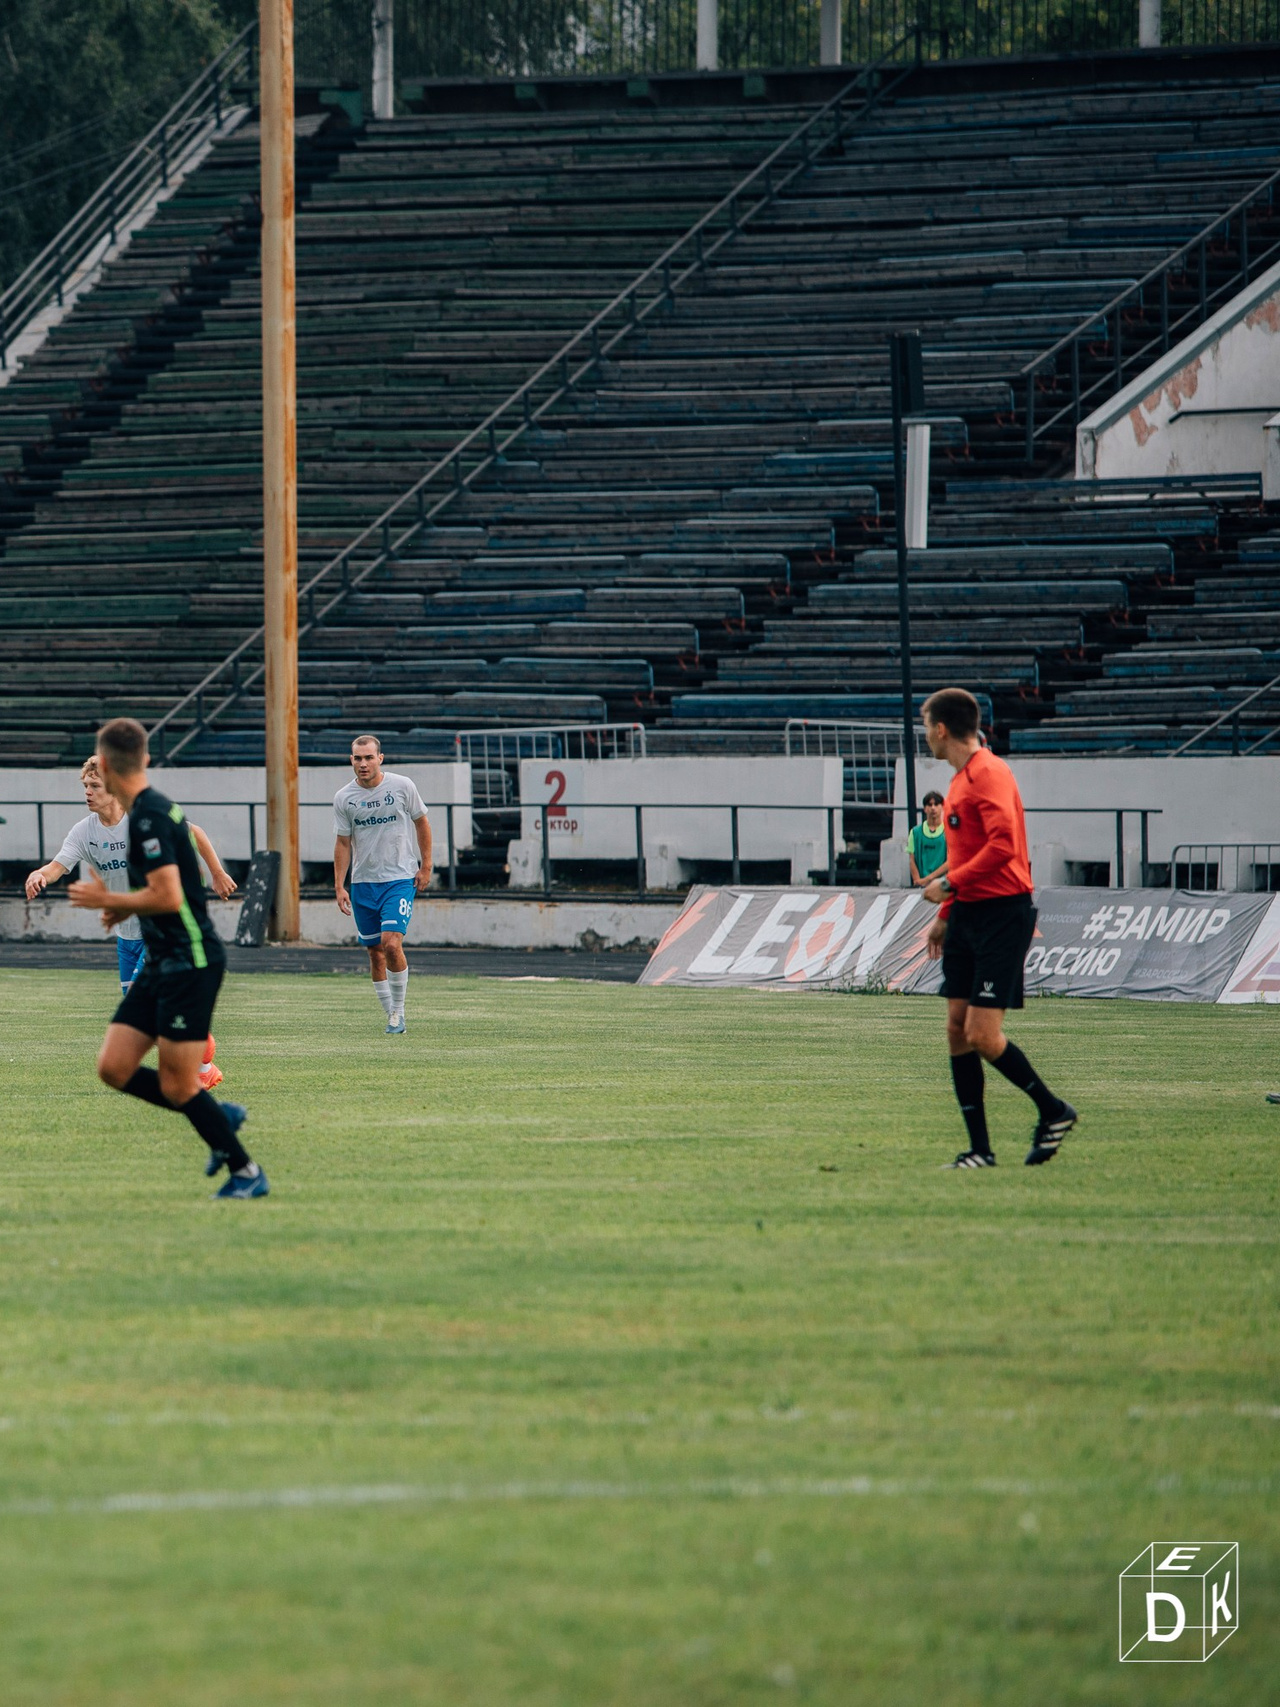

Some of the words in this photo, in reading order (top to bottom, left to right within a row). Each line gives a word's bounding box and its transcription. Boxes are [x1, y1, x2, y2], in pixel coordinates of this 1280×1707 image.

[544, 770, 567, 817] 2
[367, 800, 381, 809] ВТБ
[354, 815, 397, 826] BetBoom
[534, 819, 578, 834] сктор
[109, 841, 126, 851] ВТБ
[96, 859, 127, 872] etBo
[1081, 905, 1231, 944] #ЗАМИР
[687, 893, 923, 978] LEON
[1024, 945, 1121, 977] ОССИЮ
